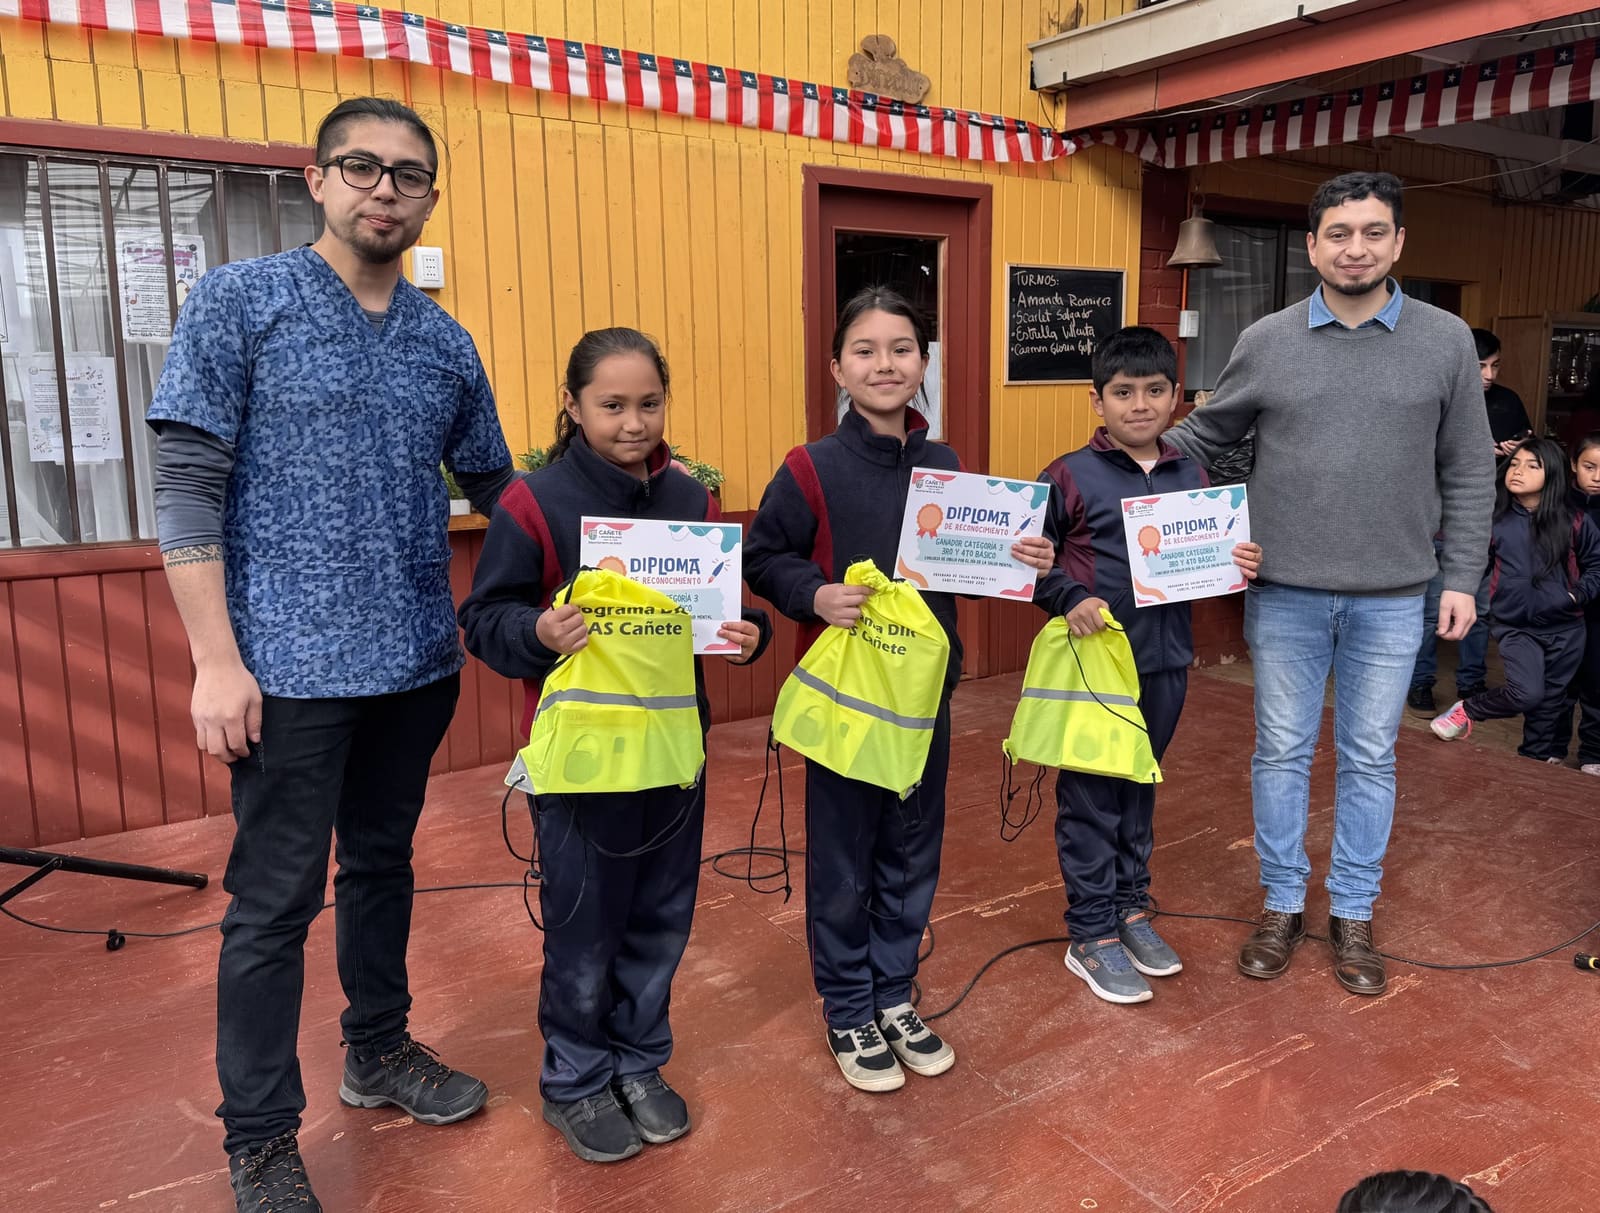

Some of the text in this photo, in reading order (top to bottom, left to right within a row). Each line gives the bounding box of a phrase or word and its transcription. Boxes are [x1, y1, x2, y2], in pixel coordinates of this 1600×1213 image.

[1014, 270, 1060, 286] TURNOS:
[1017, 291, 1064, 308] Amanda
[1016, 308, 1093, 326] Scarlet Salgado
[946, 506, 1010, 526] DIPLOMA
[954, 524, 1009, 536] RECONOCIMIENTO
[1162, 517, 1218, 536] DIPLOMA
[936, 538, 962, 546] GANADOR
[964, 539, 997, 550] CATEGORÍA
[1174, 533, 1219, 544] RECONOCIMIENTO
[942, 547, 953, 555] 3RO
[961, 549, 973, 557] 4TO
[1161, 551, 1184, 560] GANADOR
[1186, 546, 1214, 557] CATEGORÍA
[630, 557, 700, 575] DIPLOMA
[642, 577, 701, 585] RECONOCIMIENTO
[694, 594, 698, 602] 3
[620, 621, 682, 635] Cañete
